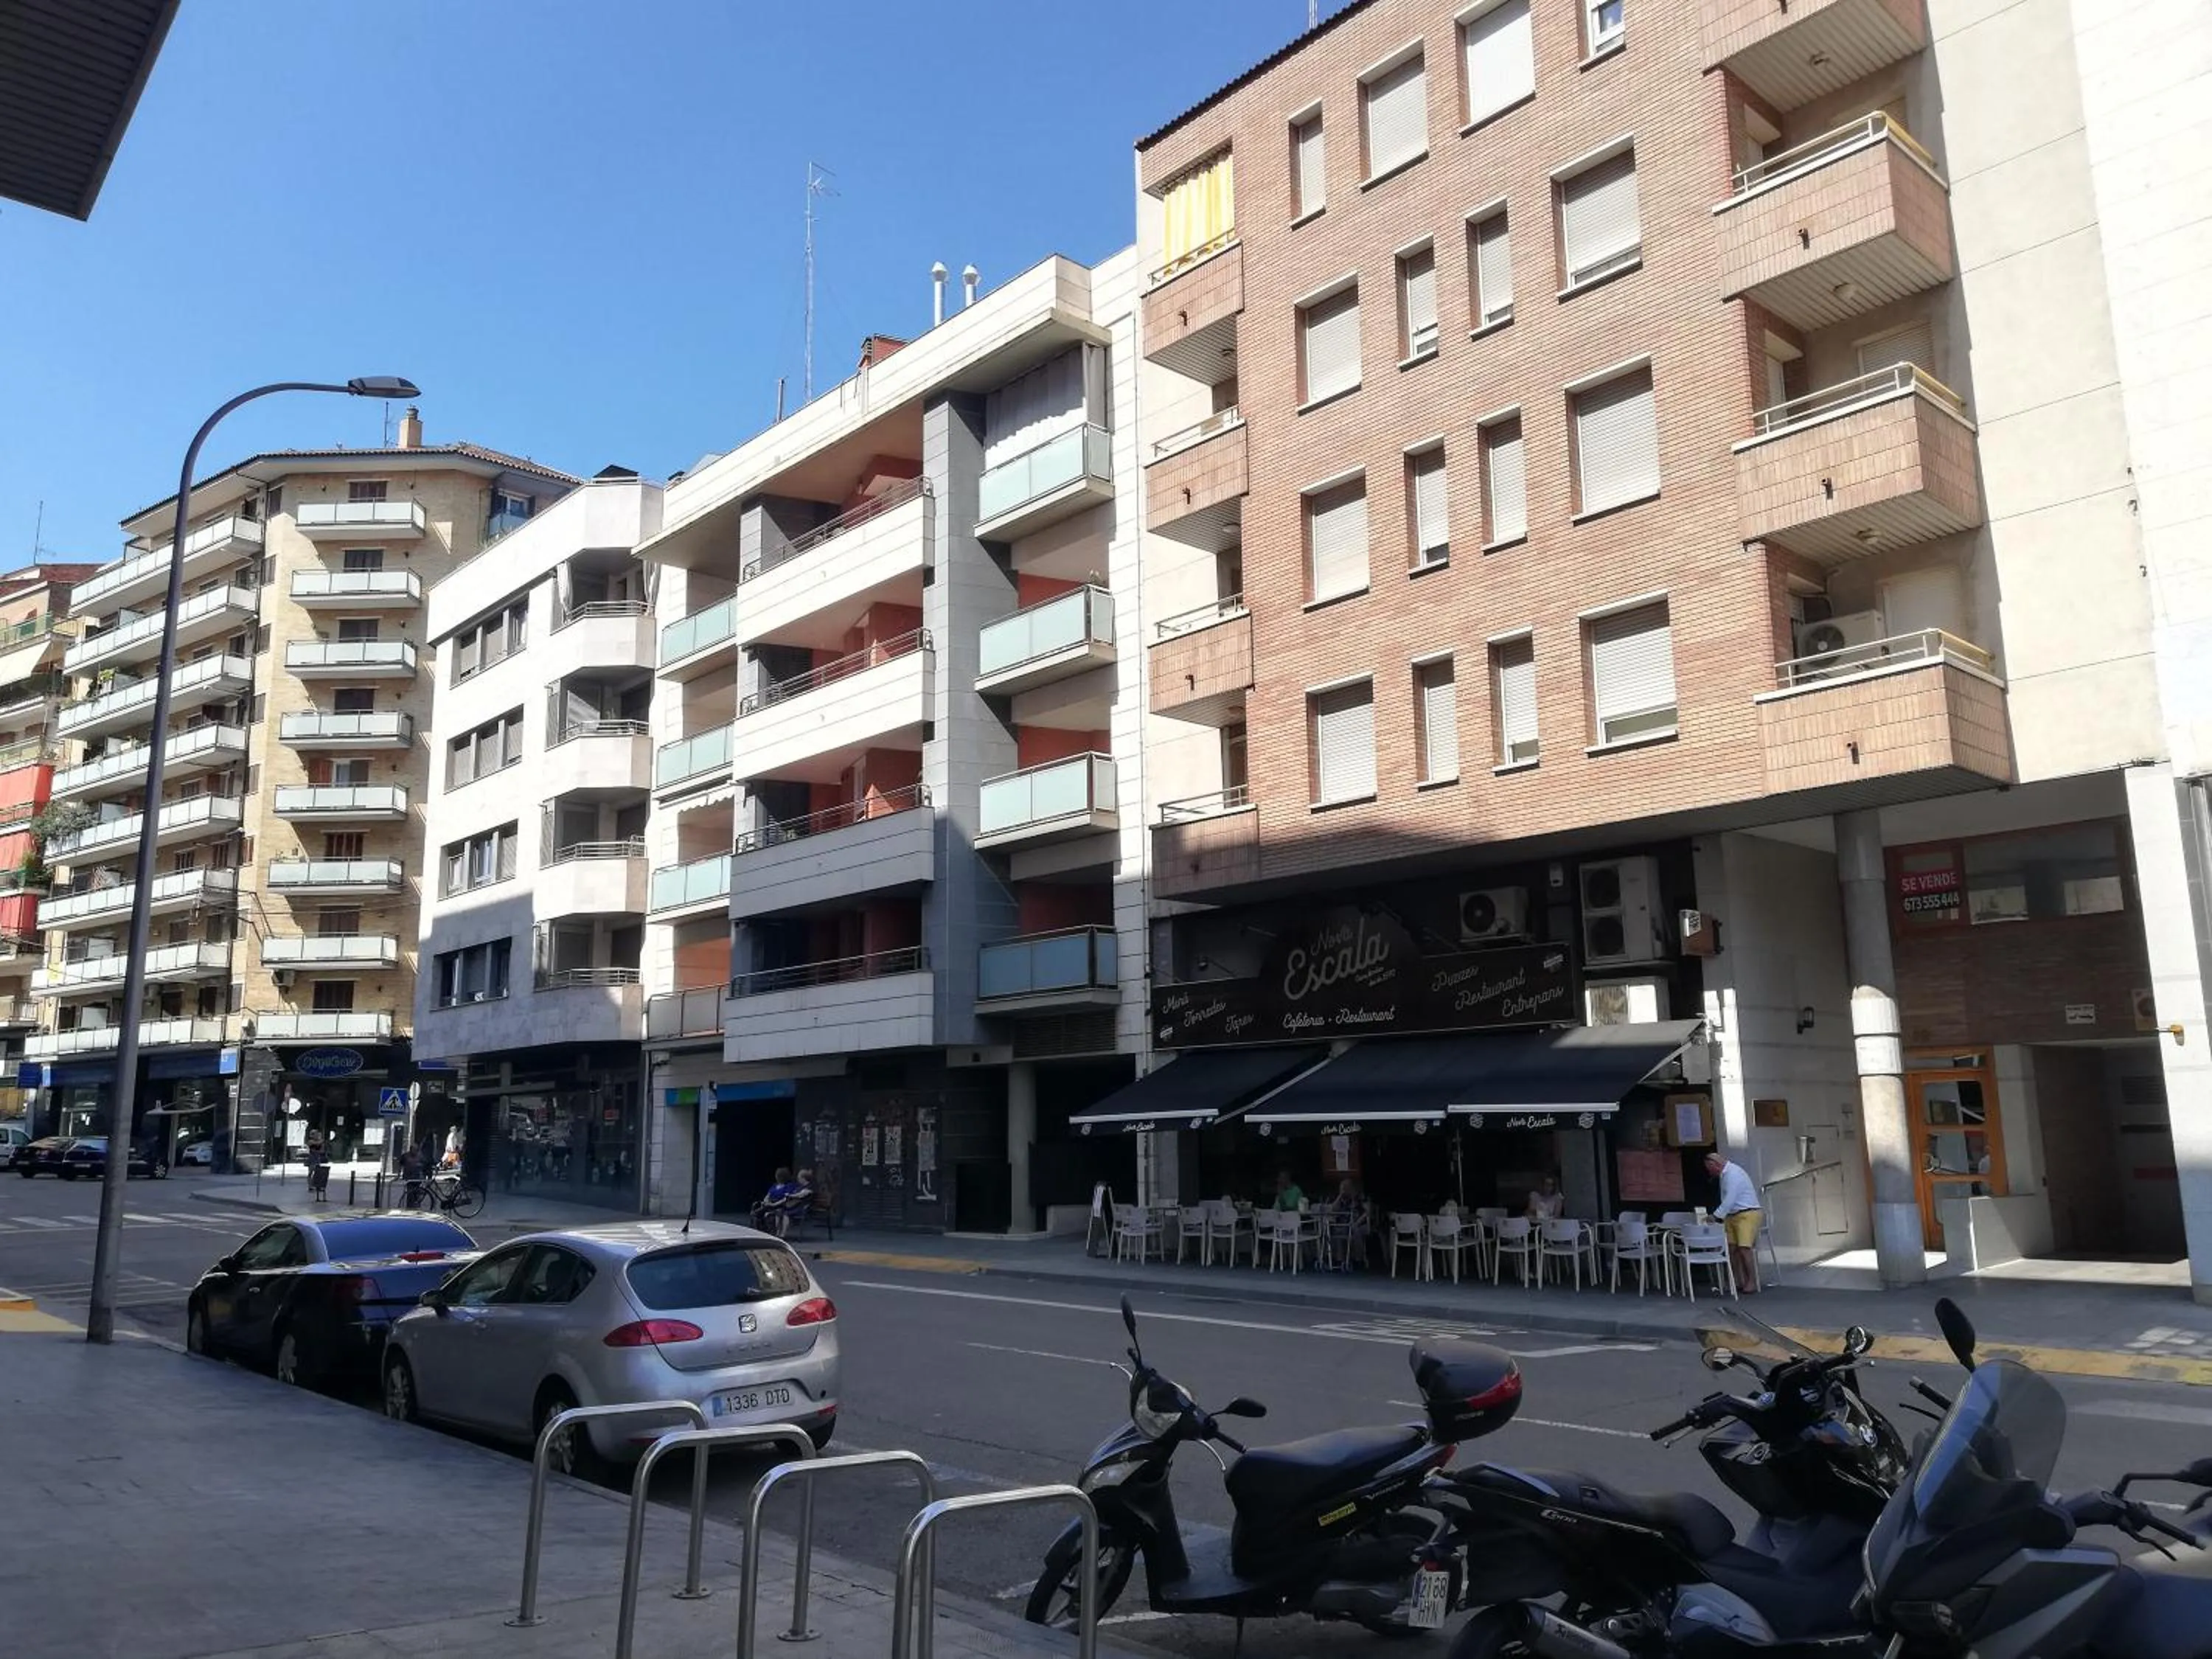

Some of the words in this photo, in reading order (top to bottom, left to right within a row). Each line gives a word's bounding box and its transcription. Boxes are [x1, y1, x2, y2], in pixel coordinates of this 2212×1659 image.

[1901, 877, 1917, 891] SE
[1918, 872, 1958, 890] VENDE
[1310, 925, 1354, 956] Nova
[1284, 916, 1390, 1000] Escala
[1501, 985, 1564, 1017] Entrepans
[1526, 1113, 1557, 1129] Escala
